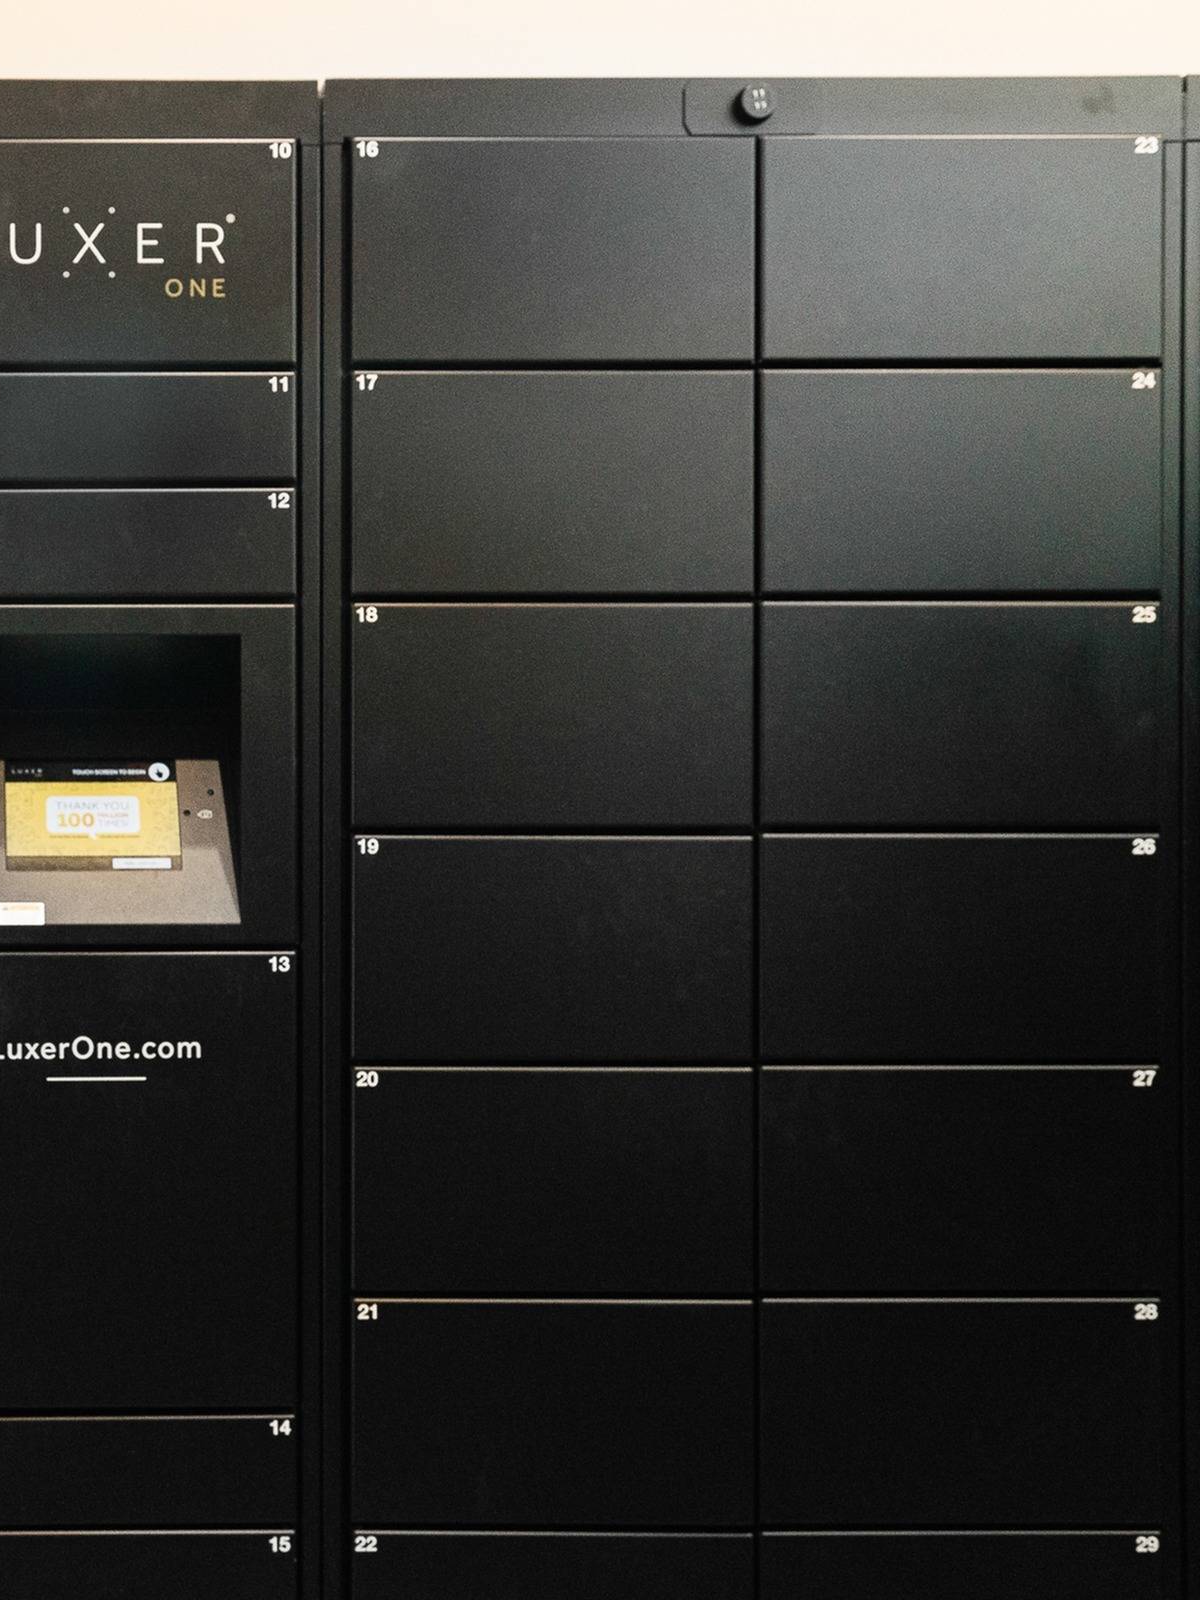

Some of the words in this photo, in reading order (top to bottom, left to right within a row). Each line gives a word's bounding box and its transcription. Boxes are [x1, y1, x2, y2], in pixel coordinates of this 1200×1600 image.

[269, 141, 292, 159] 10
[356, 139, 379, 158] 16
[1134, 136, 1159, 154] 23
[164, 278, 226, 298] ONE
[268, 376, 289, 393] 11
[355, 374, 379, 391] 17
[1131, 372, 1157, 389] 24
[267, 492, 290, 509] 12
[355, 605, 379, 623] 18
[1132, 606, 1157, 624] 25
[72, 768, 94, 776] TOUCH
[57, 801, 98, 810] THANK
[103, 801, 129, 810] YOU
[57, 812, 94, 828] 100
[357, 837, 380, 855] 19
[1131, 837, 1157, 855] 26
[268, 955, 291, 973] 13
[356, 1070, 379, 1088] 20
[1132, 1069, 1157, 1087] 27
[357, 1303, 378, 1320] 21
[1134, 1303, 1159, 1320] 28
[269, 1419, 292, 1436] 14
[268, 1535, 292, 1553] 15
[355, 1535, 378, 1553] 22
[1135, 1535, 1160, 1553] 29
